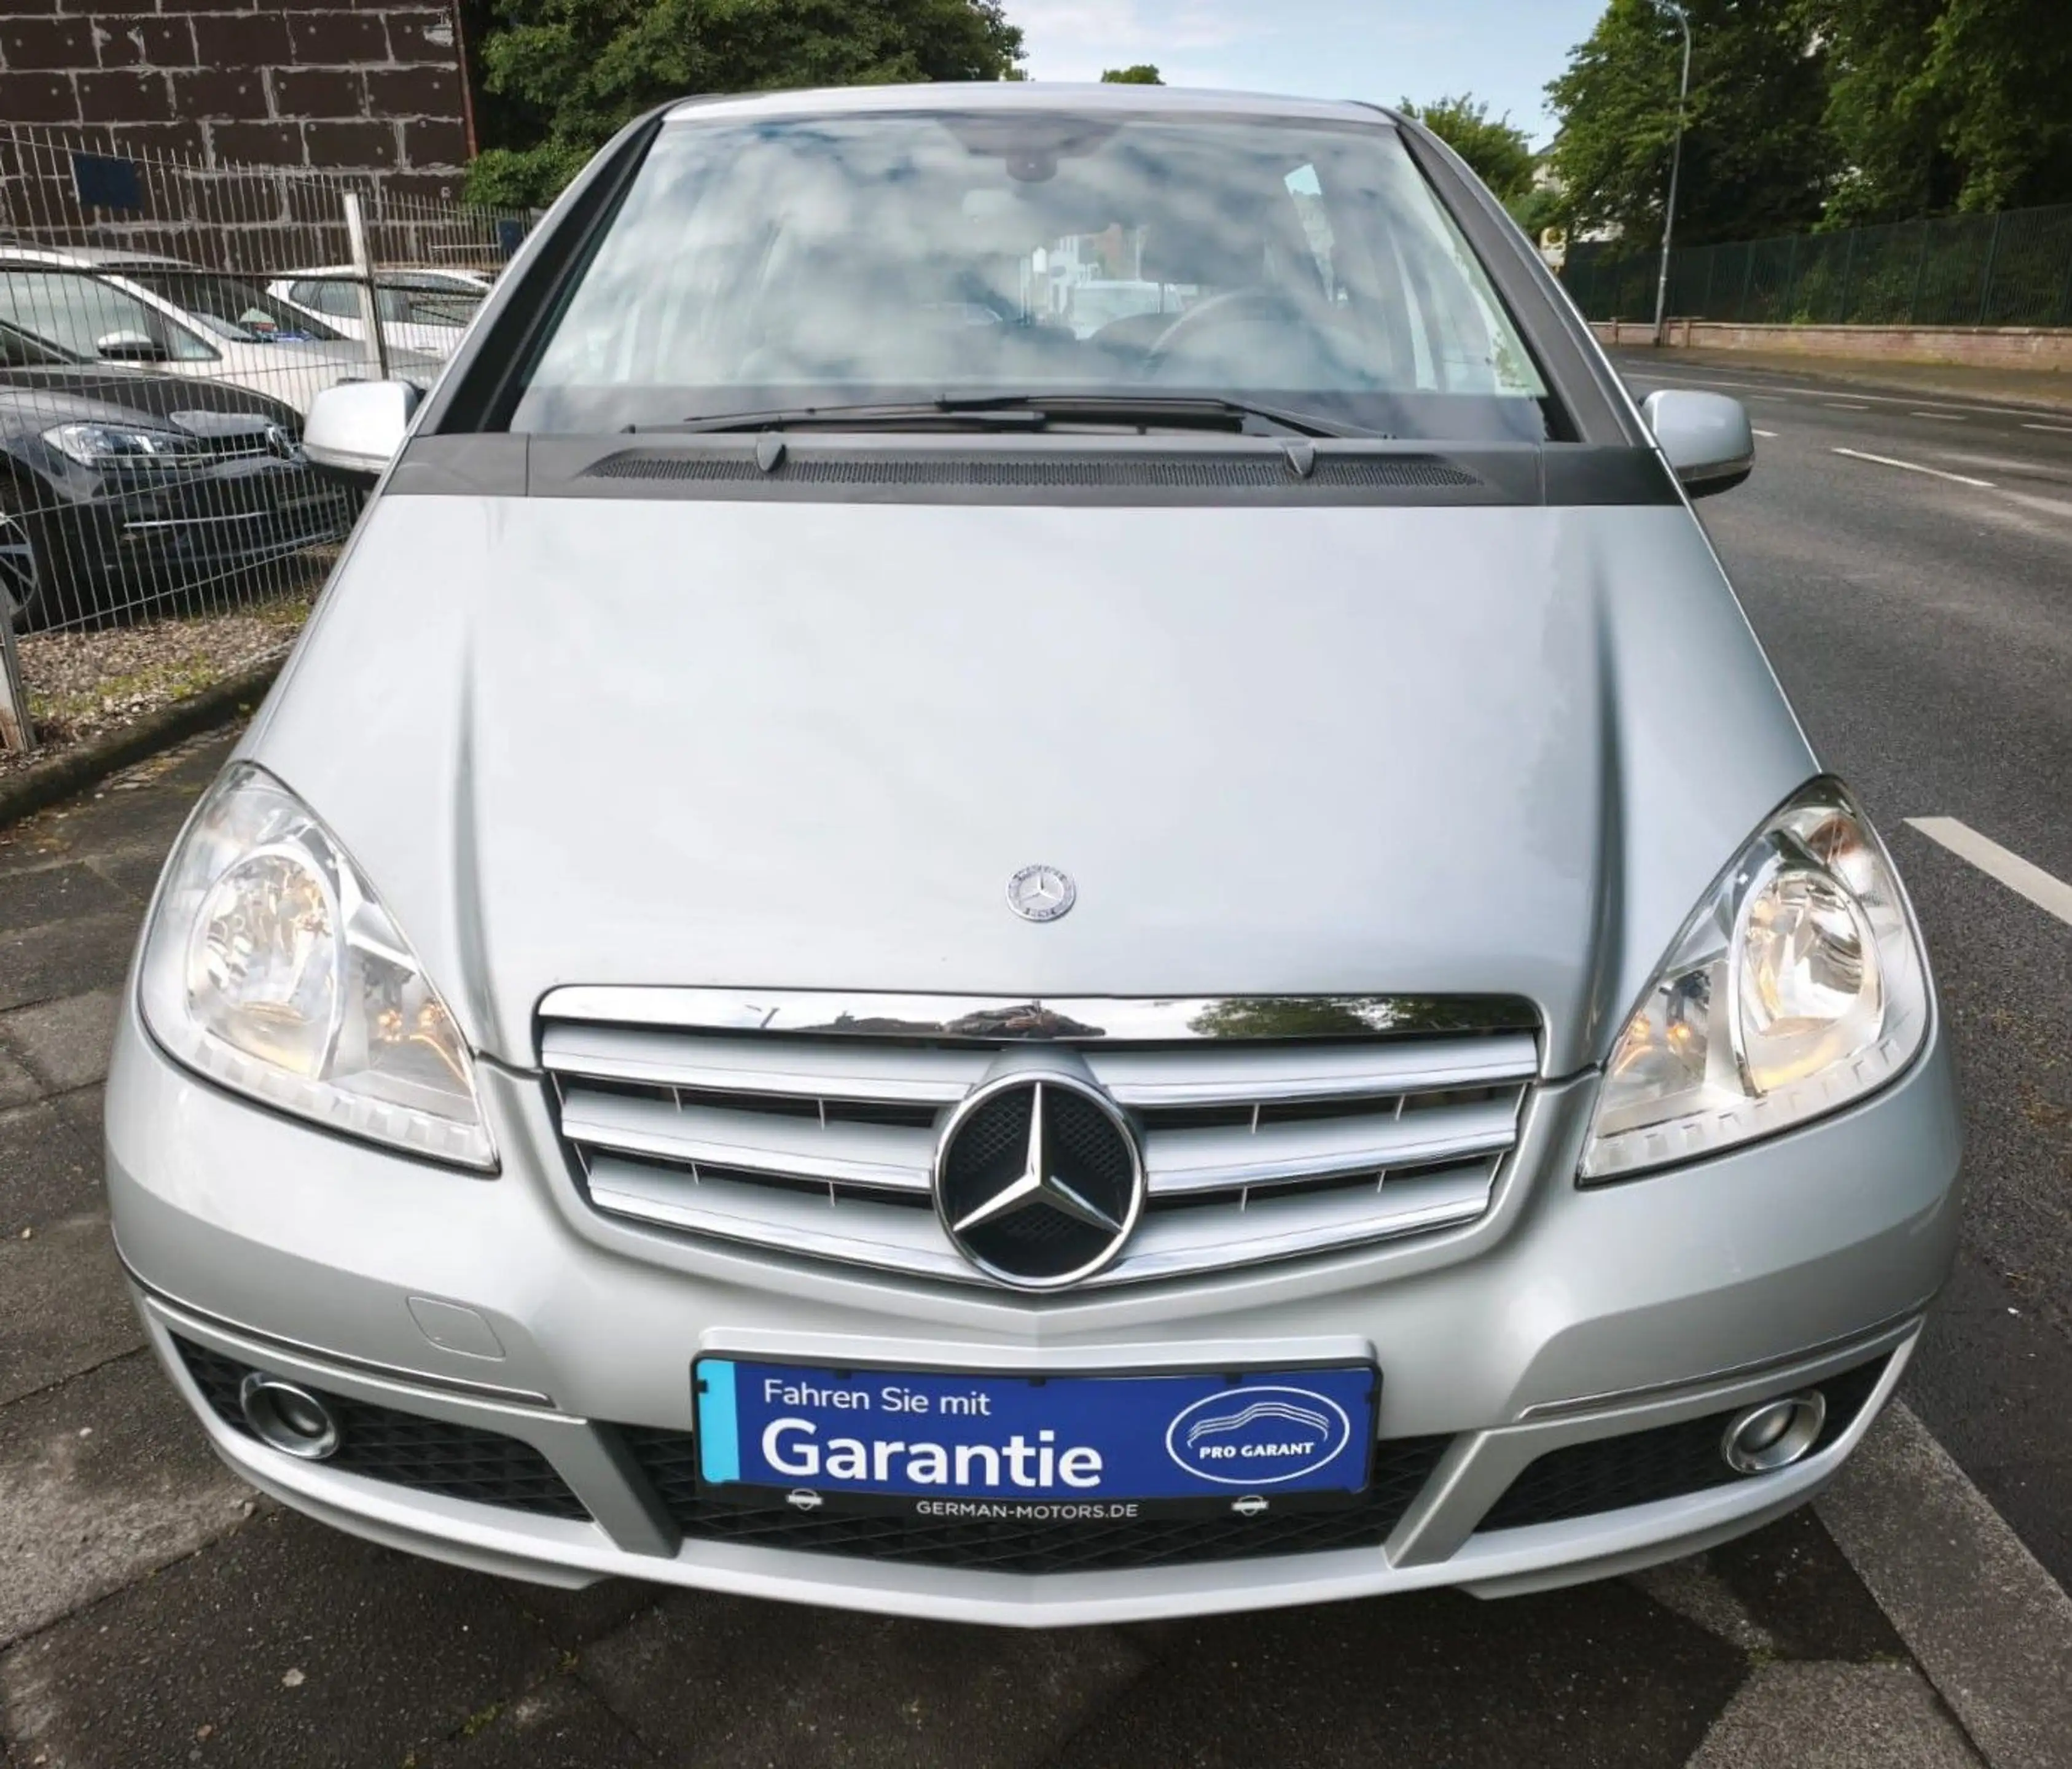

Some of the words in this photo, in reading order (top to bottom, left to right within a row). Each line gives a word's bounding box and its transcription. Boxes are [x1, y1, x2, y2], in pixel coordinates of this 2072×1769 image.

[764, 1378, 870, 1410] Fahren
[881, 1386, 929, 1413] Sie
[940, 1391, 991, 1416] mit
[762, 1417, 1103, 1488] Garantie
[1199, 1445, 1237, 1459] PRO
[1241, 1442, 1315, 1457] GARANT
[916, 1500, 1140, 1520] GERMAN-MOTORS.DE
